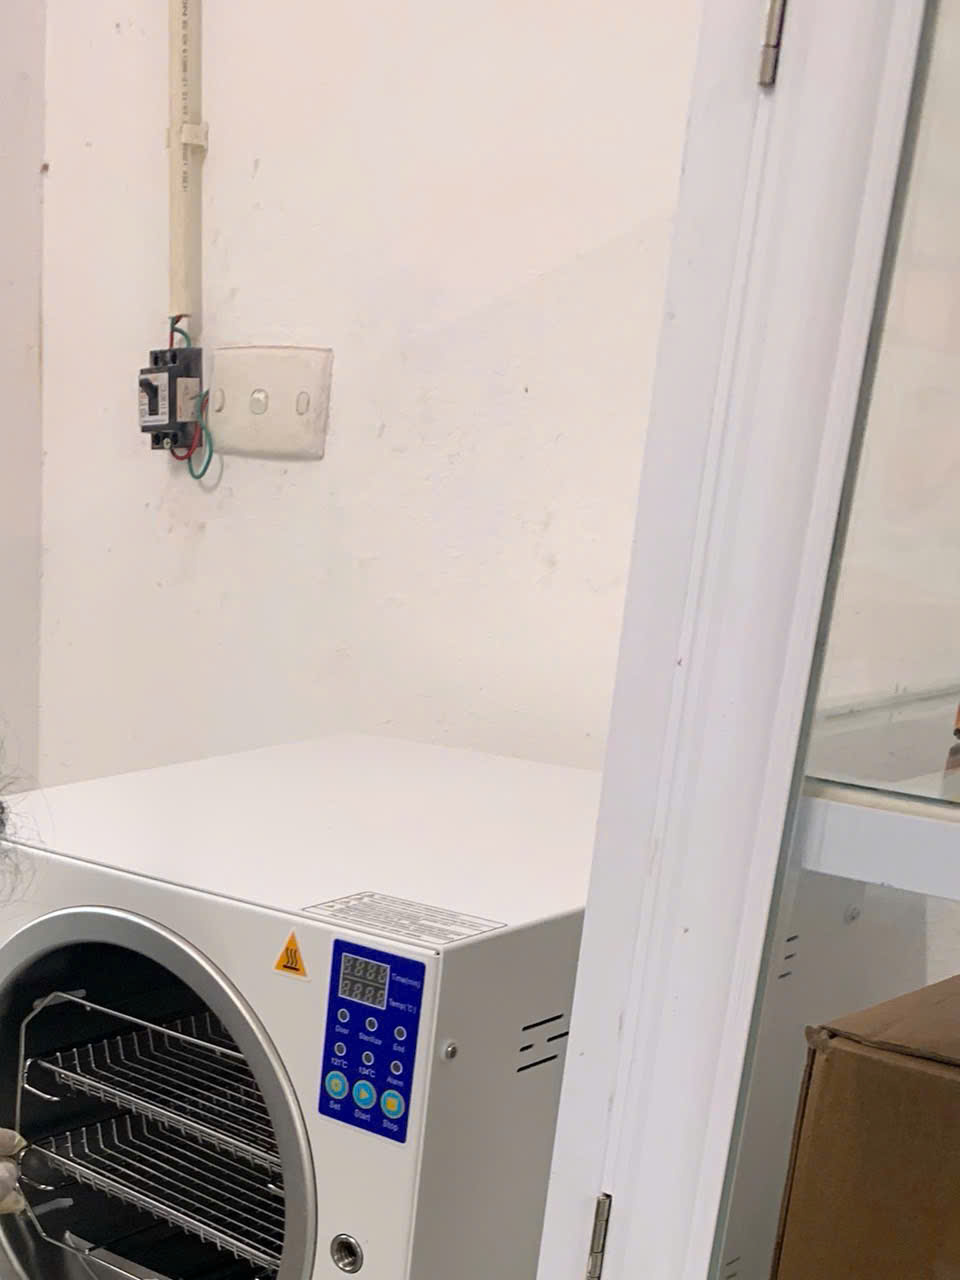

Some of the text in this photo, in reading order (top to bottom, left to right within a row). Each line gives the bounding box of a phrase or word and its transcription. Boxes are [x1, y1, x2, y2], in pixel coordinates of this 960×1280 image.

[328, 1100, 342, 1111] Set
[353, 1109, 372, 1123] Start
[382, 1119, 400, 1133] Stop
